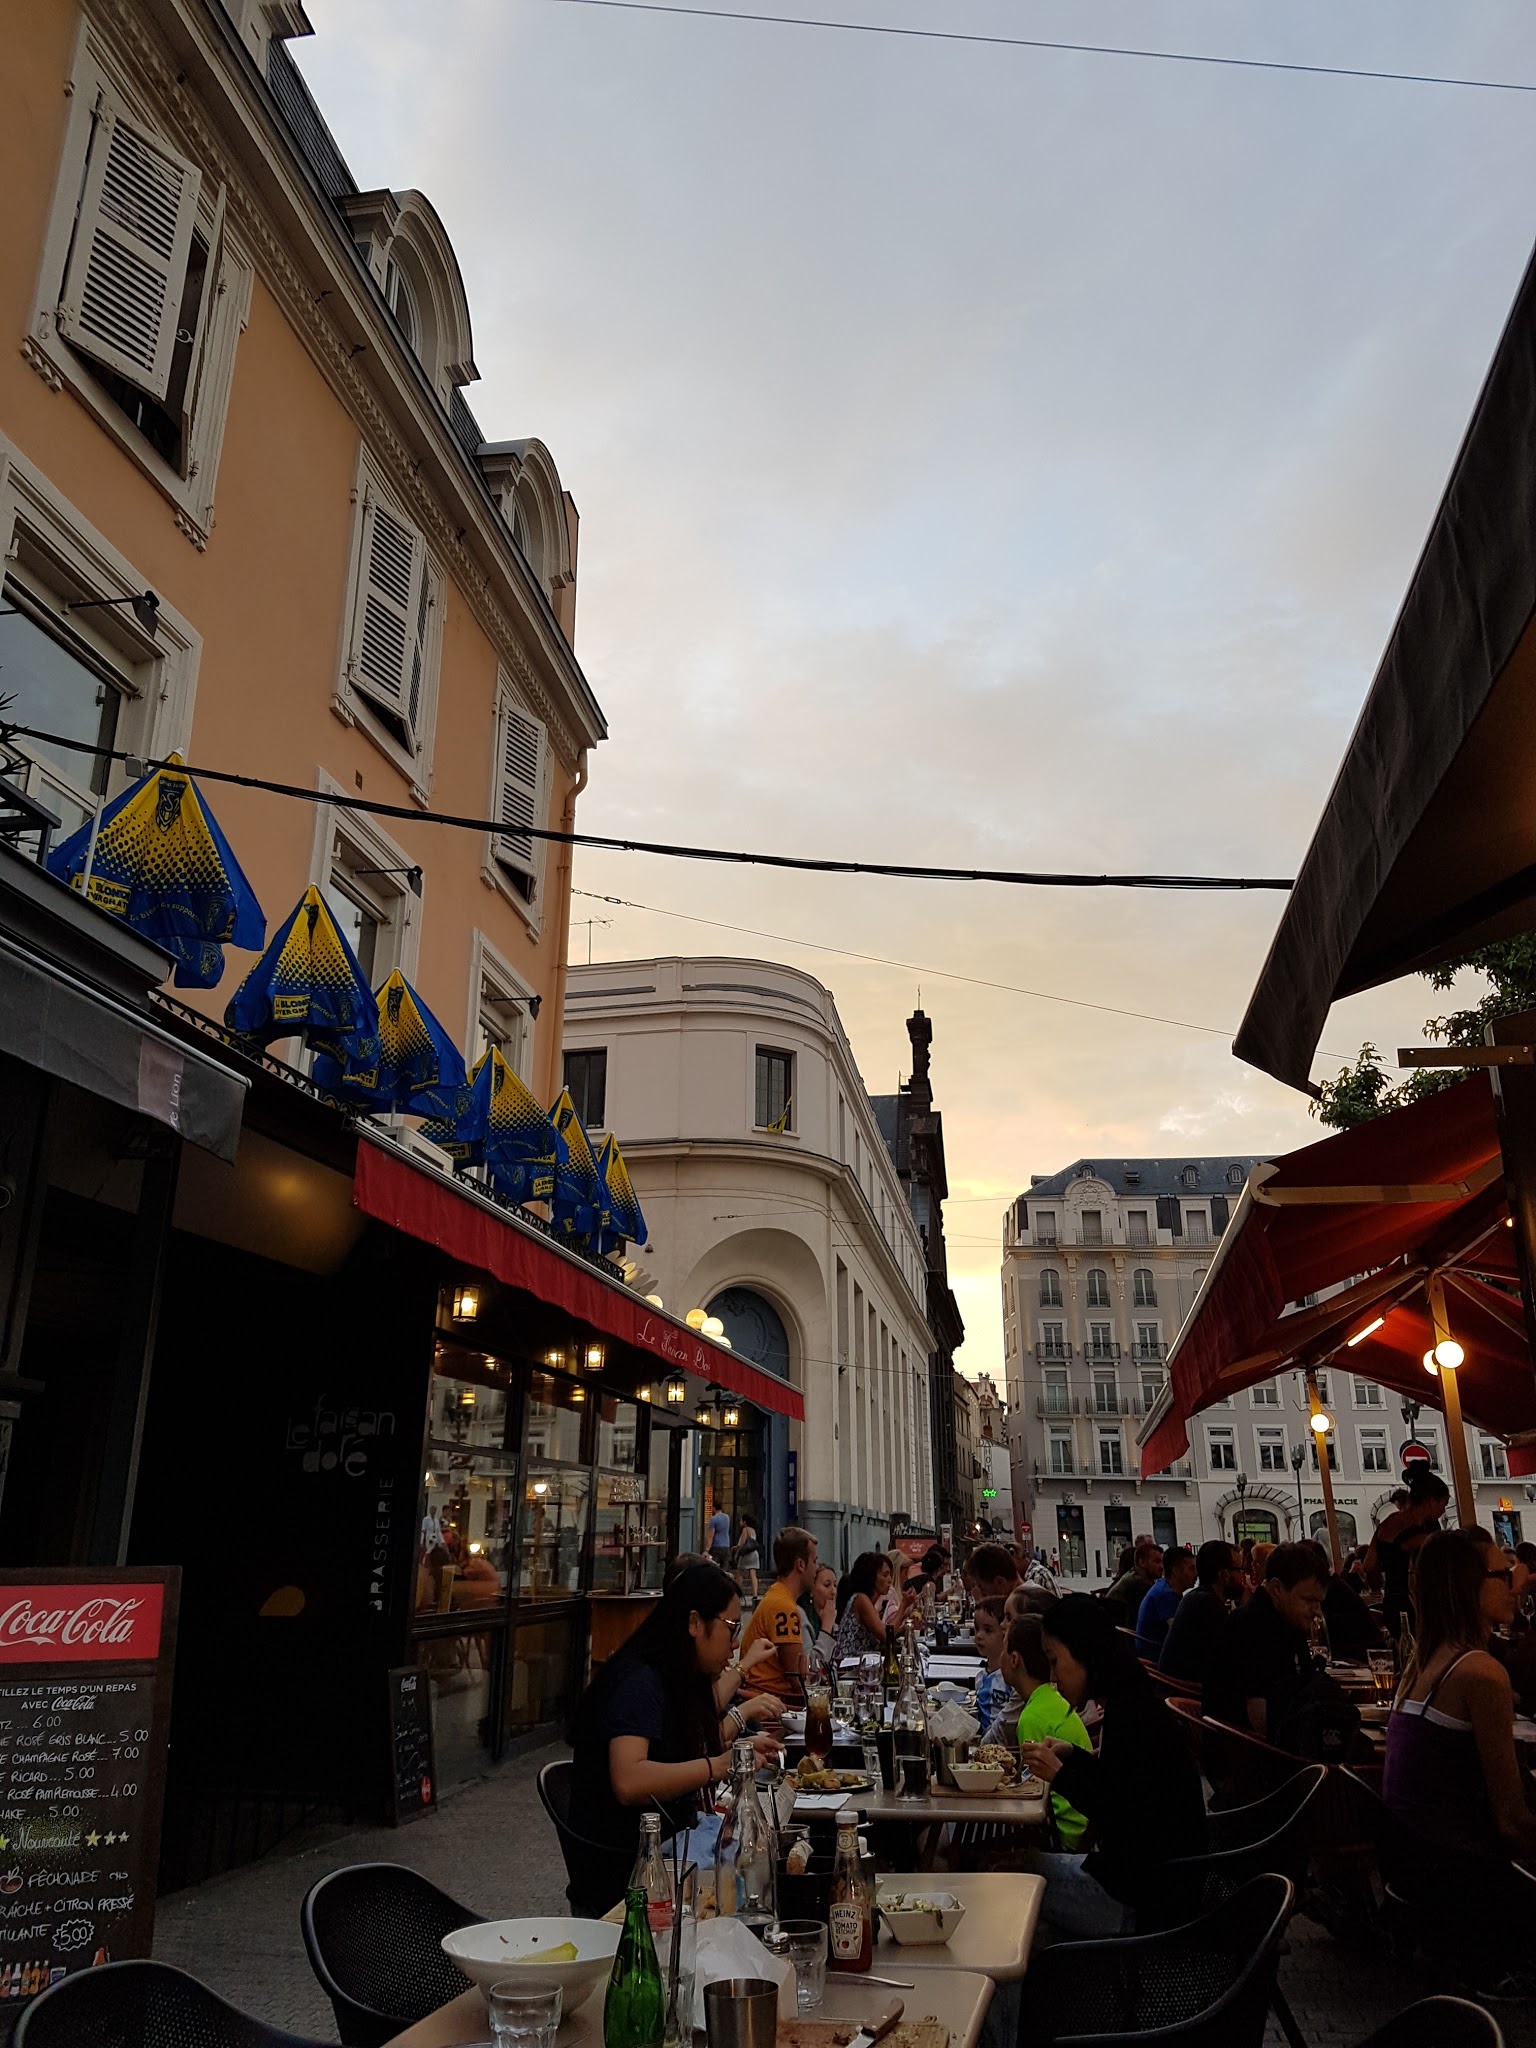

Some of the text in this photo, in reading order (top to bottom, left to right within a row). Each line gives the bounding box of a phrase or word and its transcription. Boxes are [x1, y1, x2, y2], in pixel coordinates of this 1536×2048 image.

[170, 1074, 182, 1107] Lion
[637, 1318, 655, 1345] Le
[314, 1393, 395, 1437] faisan
[286, 1417, 312, 1449] Le
[369, 1476, 394, 1611] BRASSERIE
[0, 1598, 146, 1647] Coca-Cola
[775, 1612, 801, 1636] 23
[31, 1687, 44, 1696] LE
[46, 1685, 78, 1695] TEMPS
[80, 1684, 104, 1694] D'UN
[105, 1683, 137, 1692] REPAS
[21, 1694, 98, 1712] AVEC Coca-Cola
[12, 1751, 70, 1765] CHAMPAGNE
[7, 1786, 35, 1800] ROSÉ
[53, 1898, 94, 1913] CITRON
[834, 1909, 857, 1920] HEINZ
[834, 1920, 859, 1930] TOMATO
